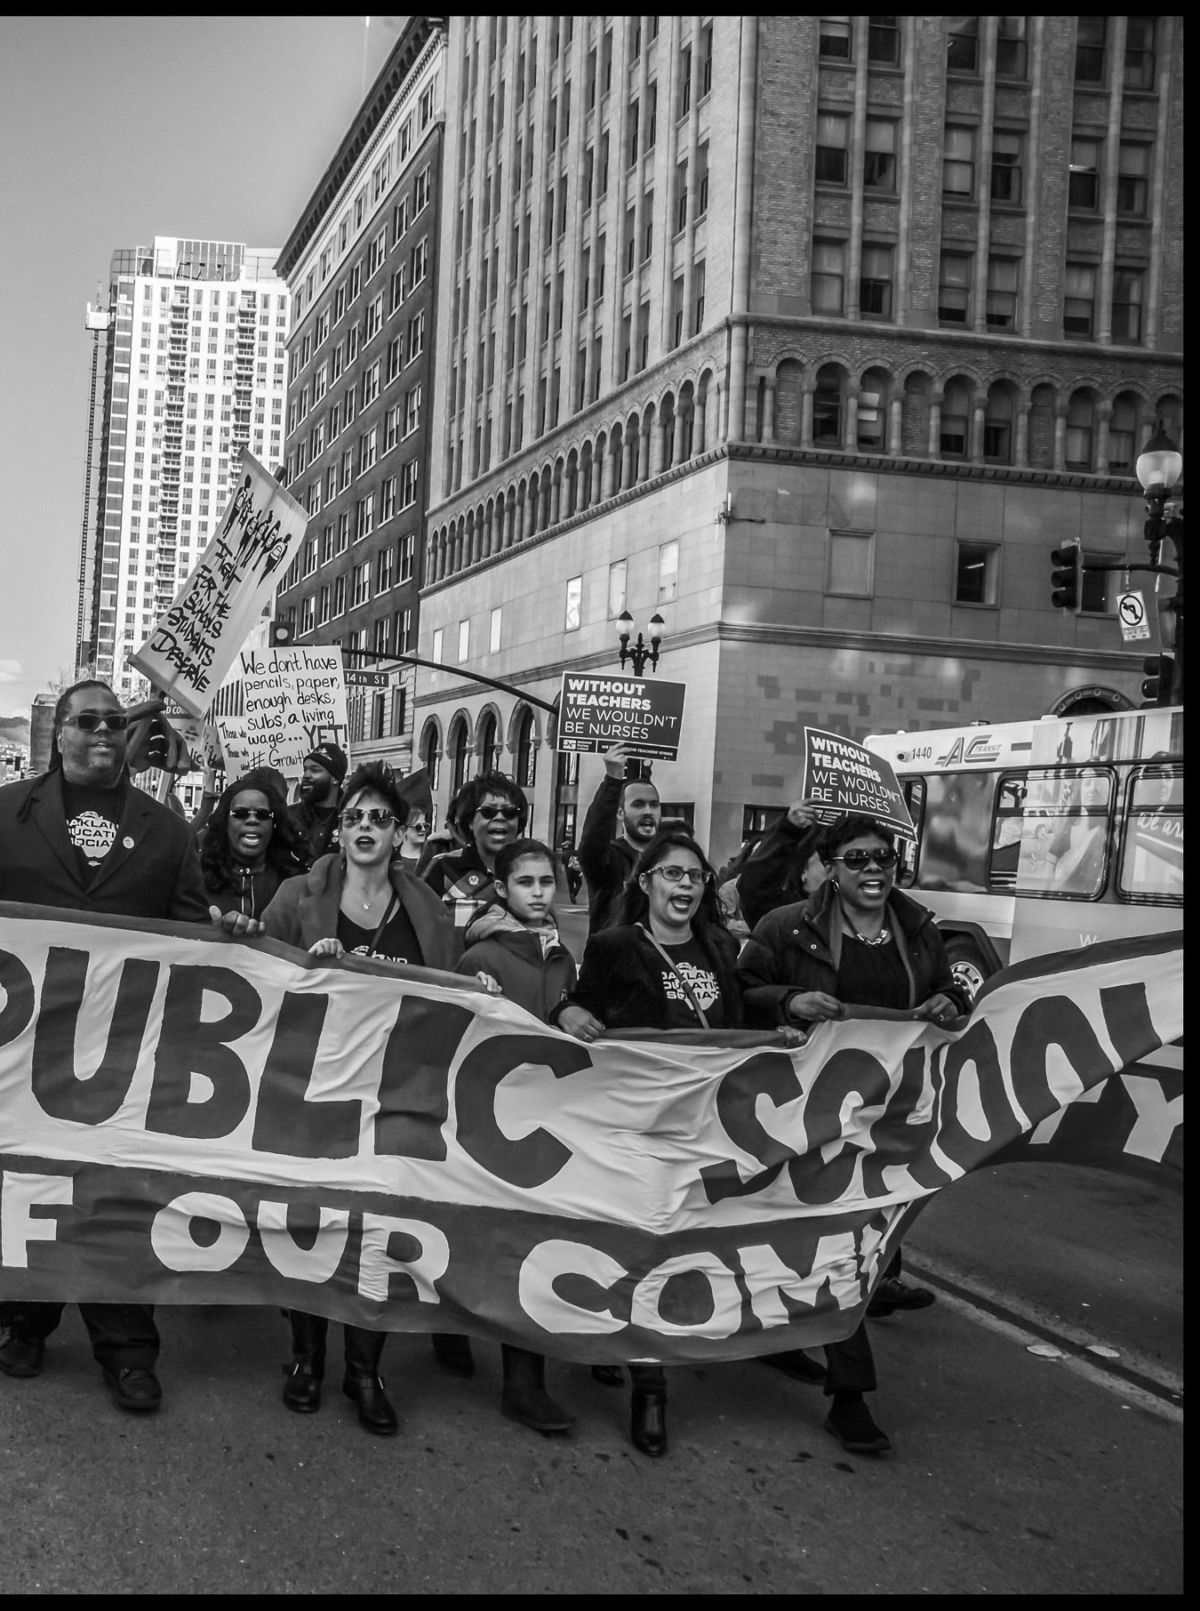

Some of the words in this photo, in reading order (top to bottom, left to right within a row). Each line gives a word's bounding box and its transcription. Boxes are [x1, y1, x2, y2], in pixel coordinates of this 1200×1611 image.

[193, 564, 217, 601] FOR
[183, 590, 222, 639] SCHOOLS
[167, 607, 215, 666] STUDENTS
[151, 627, 210, 693] DESERVE
[240, 651, 266, 674] We
[268, 650, 302, 673] don't
[303, 650, 338, 670] have
[245, 675, 294, 697] pencils,
[296, 676, 340, 695] paper,
[346, 671, 368, 684] 14th
[374, 673, 385, 685] St
[568, 678, 646, 696] WITHOUT
[246, 692, 291, 713] enough
[297, 692, 335, 706] desks,
[566, 693, 652, 711] TEACHERS
[247, 714, 287, 731] subs,
[288, 712, 299, 724] a
[302, 708, 335, 726] living
[566, 706, 592, 720] WE
[596, 708, 678, 729] WOULDN'T
[303, 723, 348, 749] YET!
[564, 721, 585, 734] BE
[589, 723, 649, 740] NURSES
[810, 736, 871, 765] WITHOUT
[912, 746, 932, 760] 1440
[934, 735, 1001, 768] AC
[811, 752, 881, 783] TEACHERS
[812, 770, 839, 786] WE
[811, 787, 833, 802] BE
[838, 790, 891, 814] NURSES
[68, 828, 116, 839] UCATI
[151, 1191, 450, 1303] OUR
